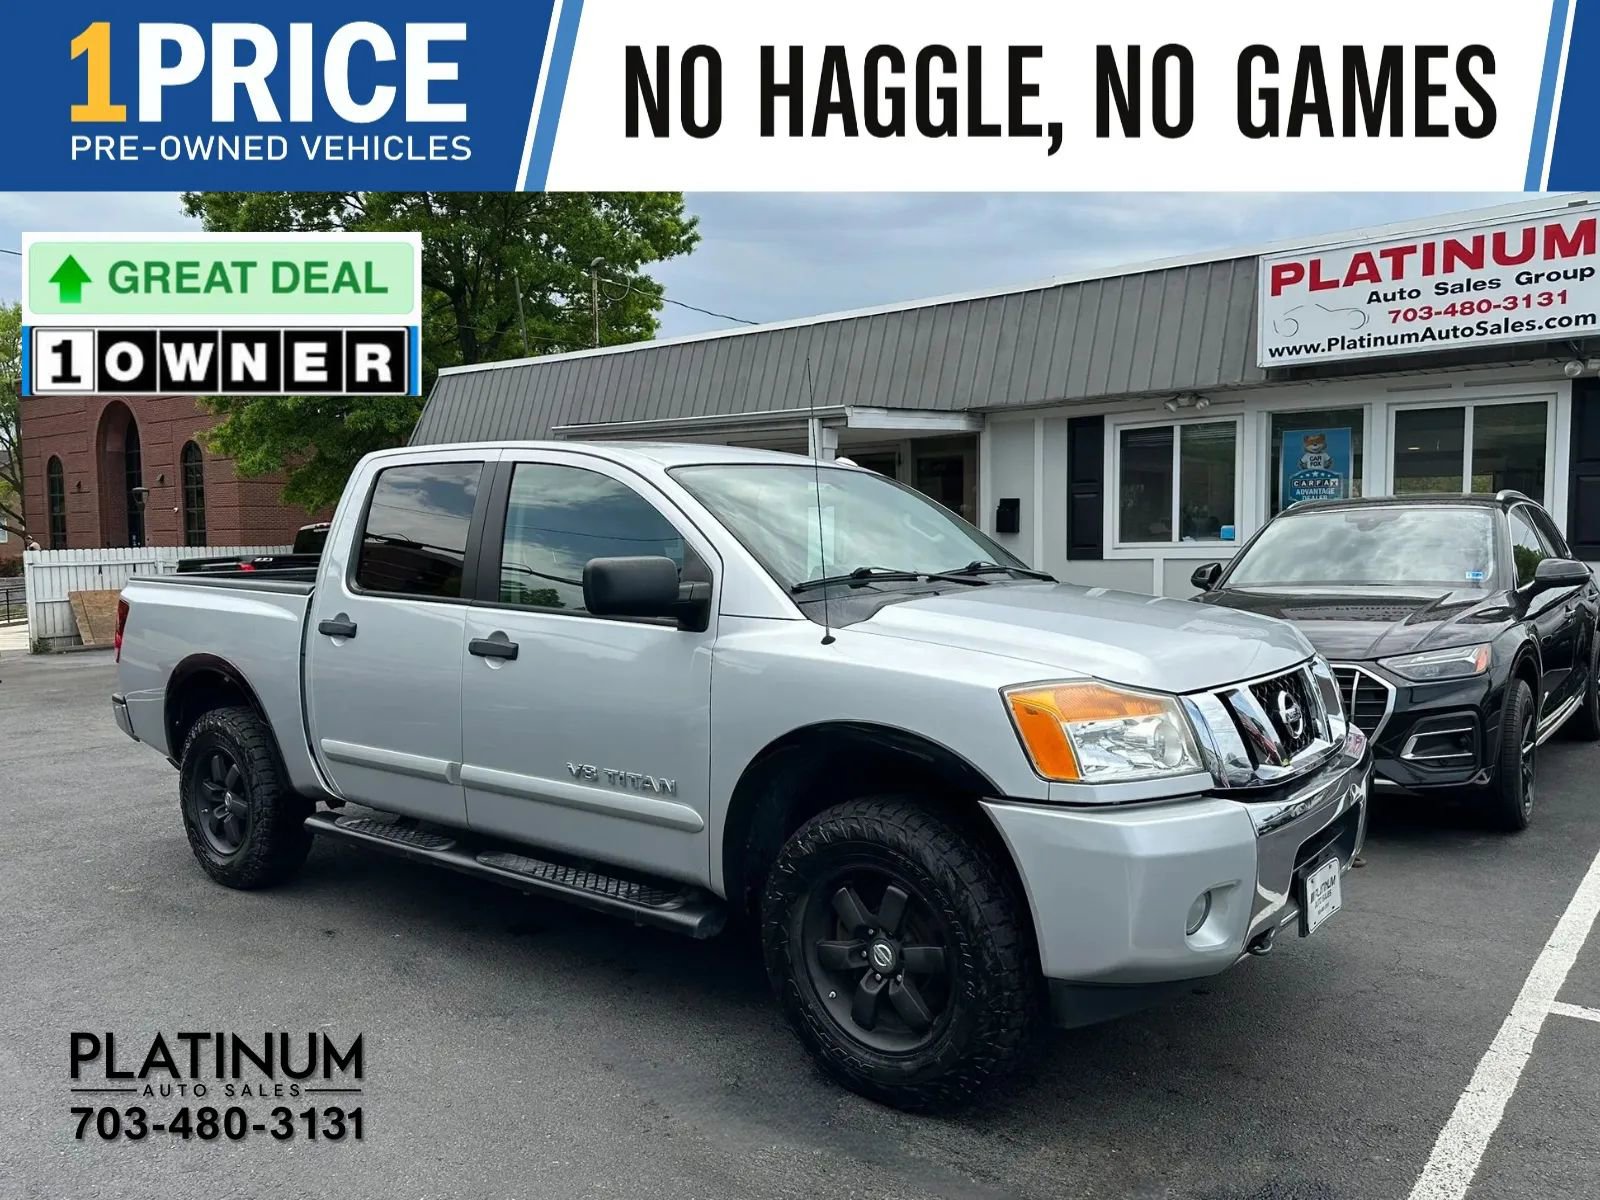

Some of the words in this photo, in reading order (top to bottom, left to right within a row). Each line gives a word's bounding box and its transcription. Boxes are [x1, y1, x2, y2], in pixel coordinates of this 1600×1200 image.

[1271, 218, 1597, 296] PLATINUM
[1366, 286, 1421, 305] Auto
[1434, 275, 1501, 297] Sales
[1515, 266, 1595, 286] Group
[1388, 289, 1567, 324] 703-480-3131
[1268, 312, 1597, 358] www.PlatinumAutoSales.com
[1293, 479, 1339, 487] CARFAX
[1295, 487, 1335, 495] ADVANTAGE
[566, 762, 598, 782] V8
[603, 768, 677, 796] TITAN
